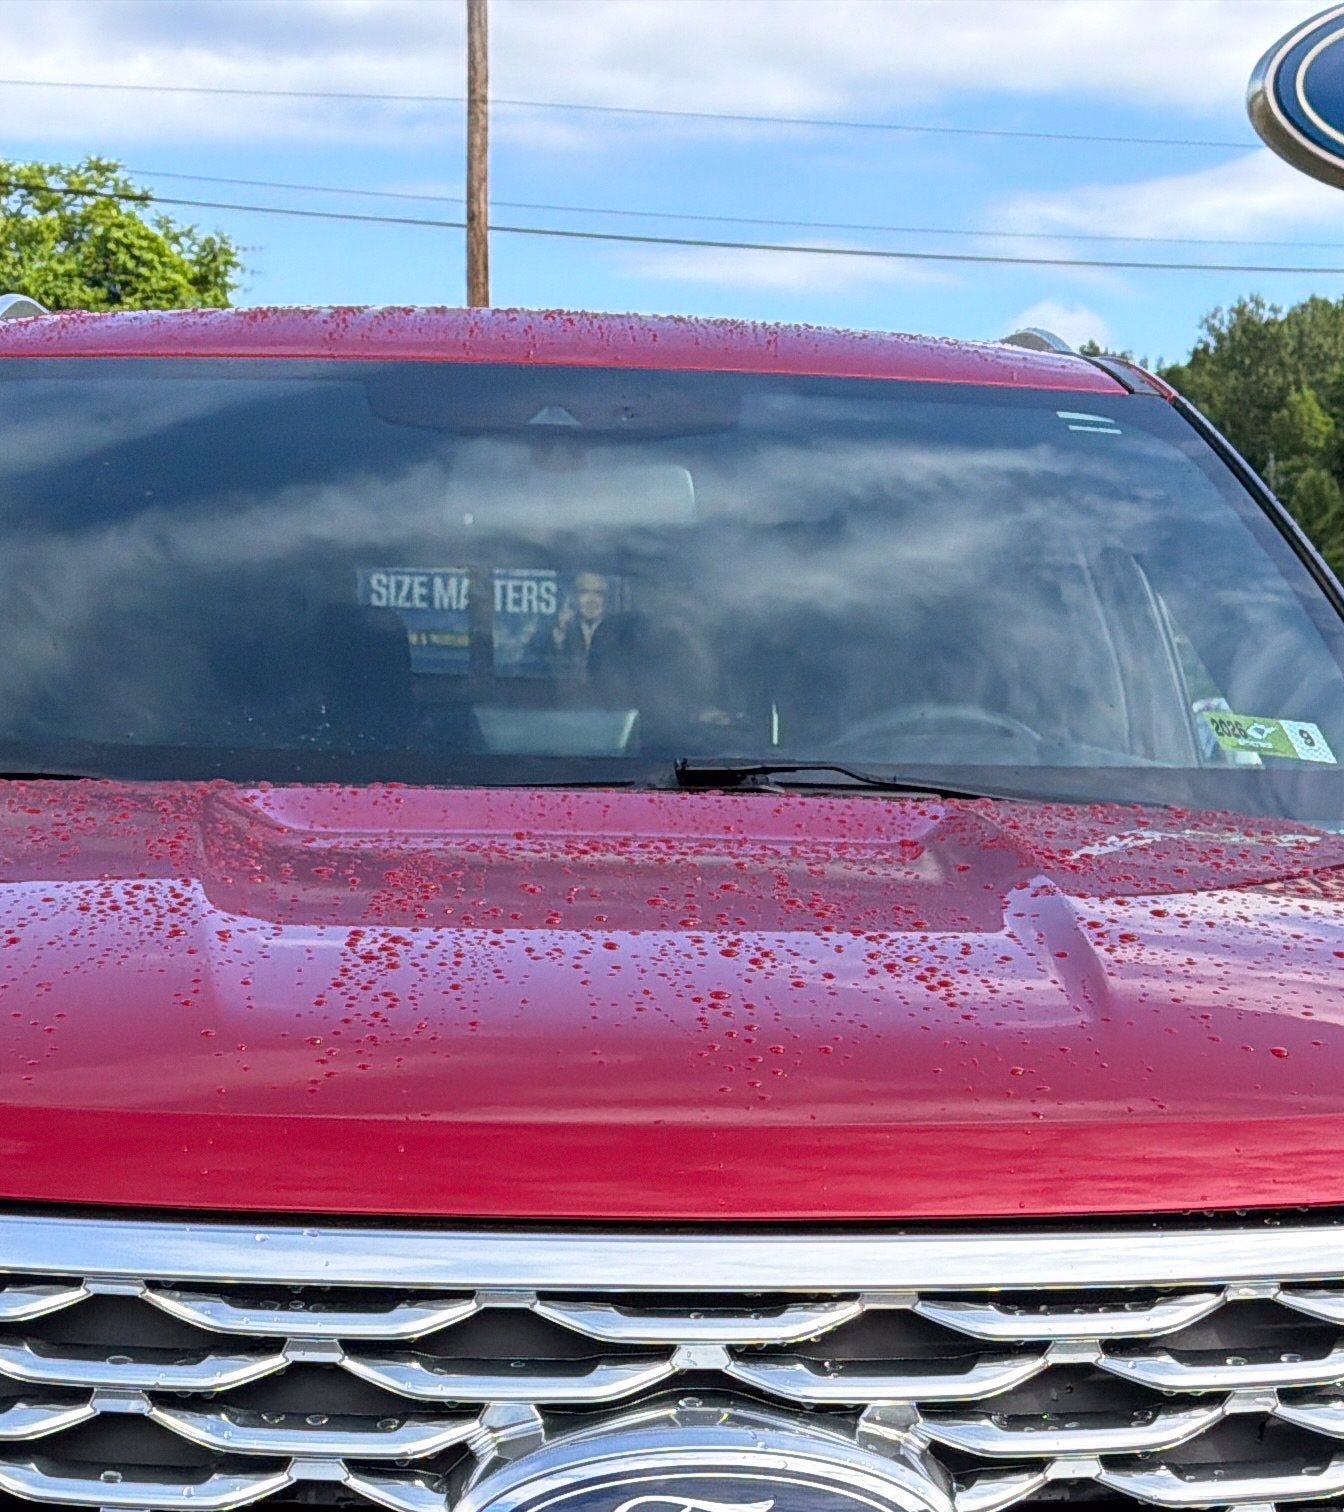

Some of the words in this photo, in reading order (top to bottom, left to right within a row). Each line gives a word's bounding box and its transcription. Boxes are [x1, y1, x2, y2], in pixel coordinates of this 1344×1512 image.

[370, 572, 428, 609] SIZE
[432, 576, 557, 615] MATERS
[1211, 717, 1248, 739] 2026
